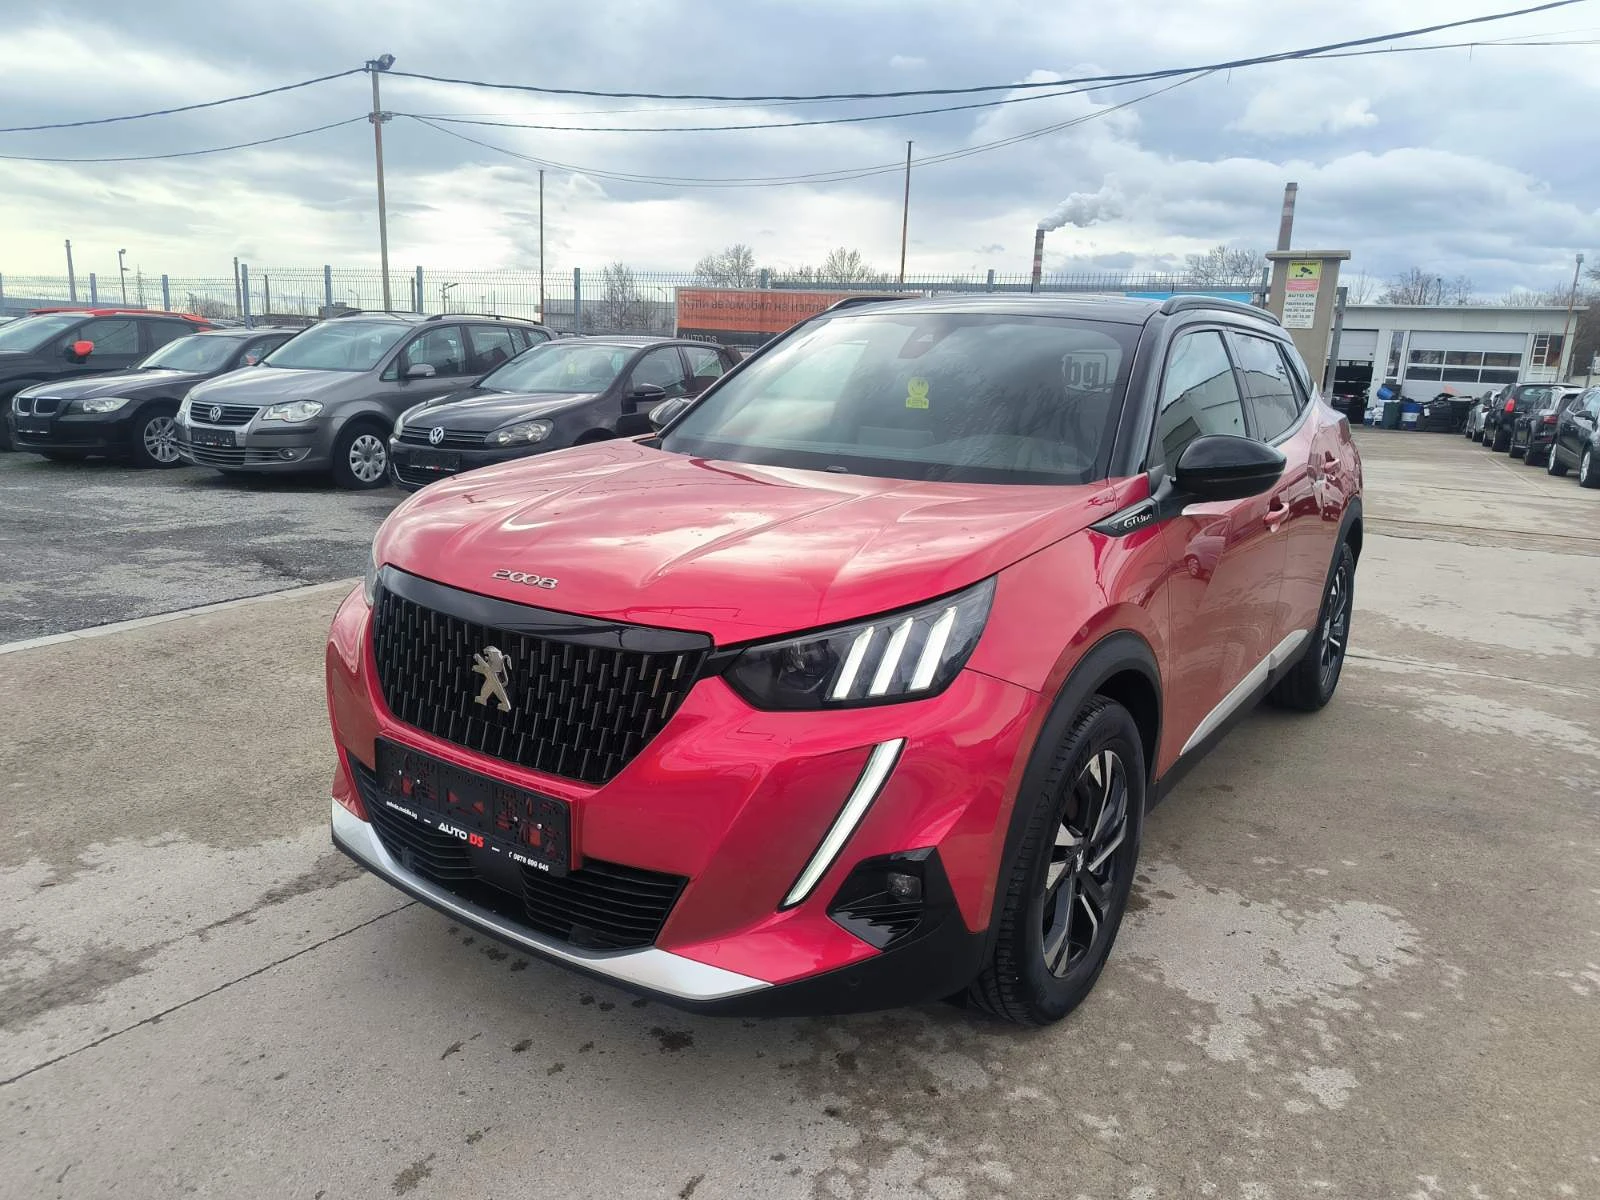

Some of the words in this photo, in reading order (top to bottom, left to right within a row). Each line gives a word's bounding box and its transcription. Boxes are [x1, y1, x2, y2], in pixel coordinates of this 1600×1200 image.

[711, 299, 771, 312] автомобил
[491, 568, 559, 590] 2008
[438, 822, 468, 840] AUTO
[469, 833, 485, 848] DS
